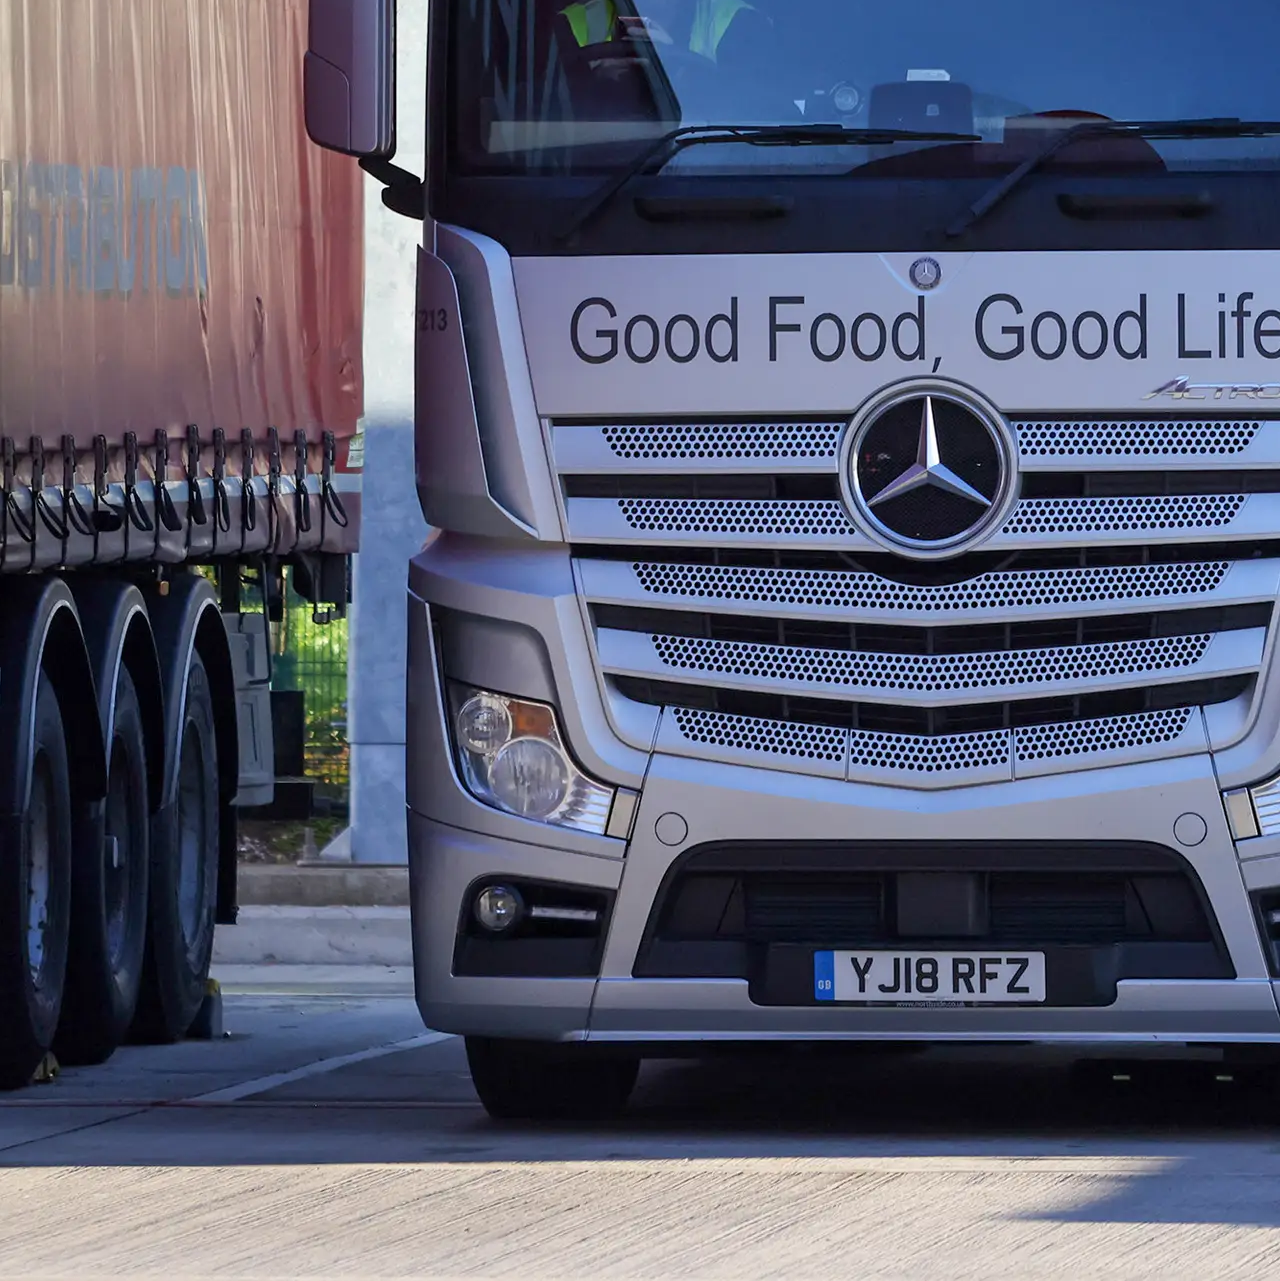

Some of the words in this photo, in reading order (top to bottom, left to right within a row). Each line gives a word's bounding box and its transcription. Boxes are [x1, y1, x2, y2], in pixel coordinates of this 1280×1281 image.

[570, 296, 739, 365] Good
[768, 295, 942, 374] Food,
[974, 292, 1148, 361] Good
[850, 956, 939, 995] YJ18
[951, 957, 1030, 995] RFZ
